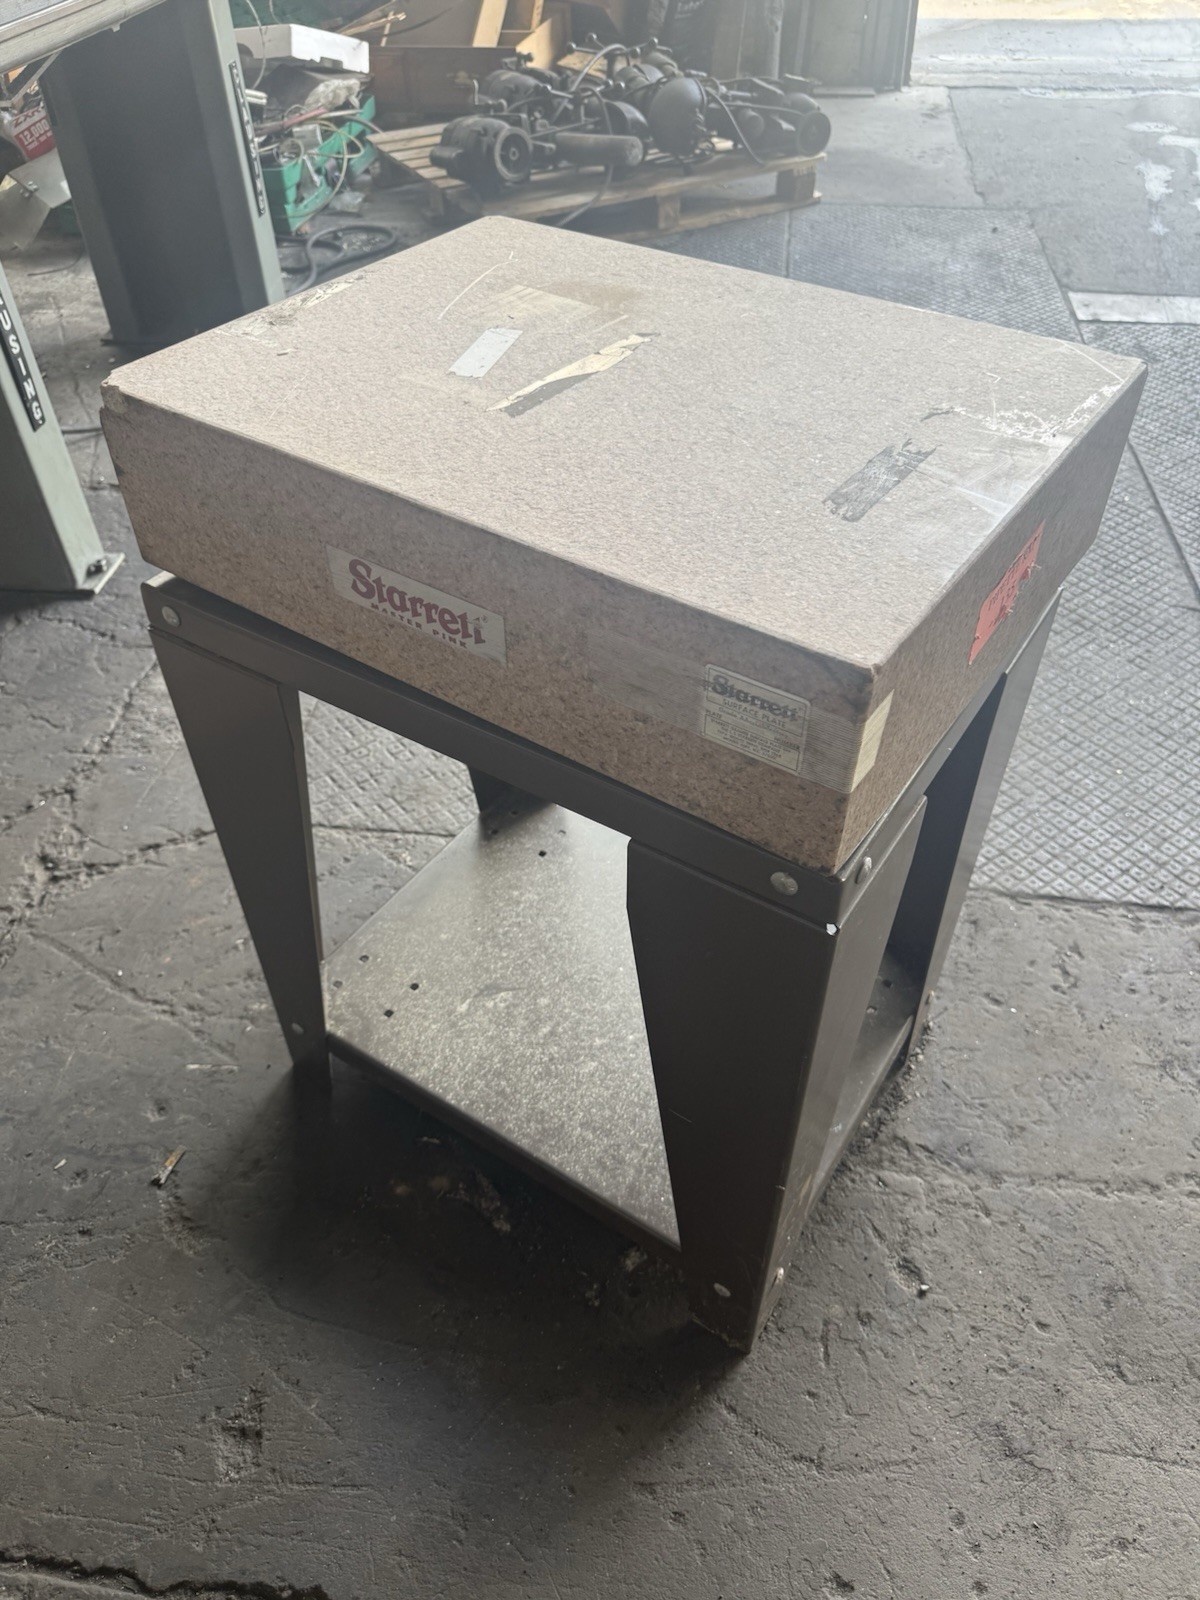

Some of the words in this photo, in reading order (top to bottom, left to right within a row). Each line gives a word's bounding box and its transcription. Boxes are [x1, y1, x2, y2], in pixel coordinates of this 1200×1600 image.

[371, 602, 423, 631] MASTER
[432, 628, 468, 649] PINK
[722, 698, 759, 717] SURFACE
[761, 713, 786, 729] PLATE
